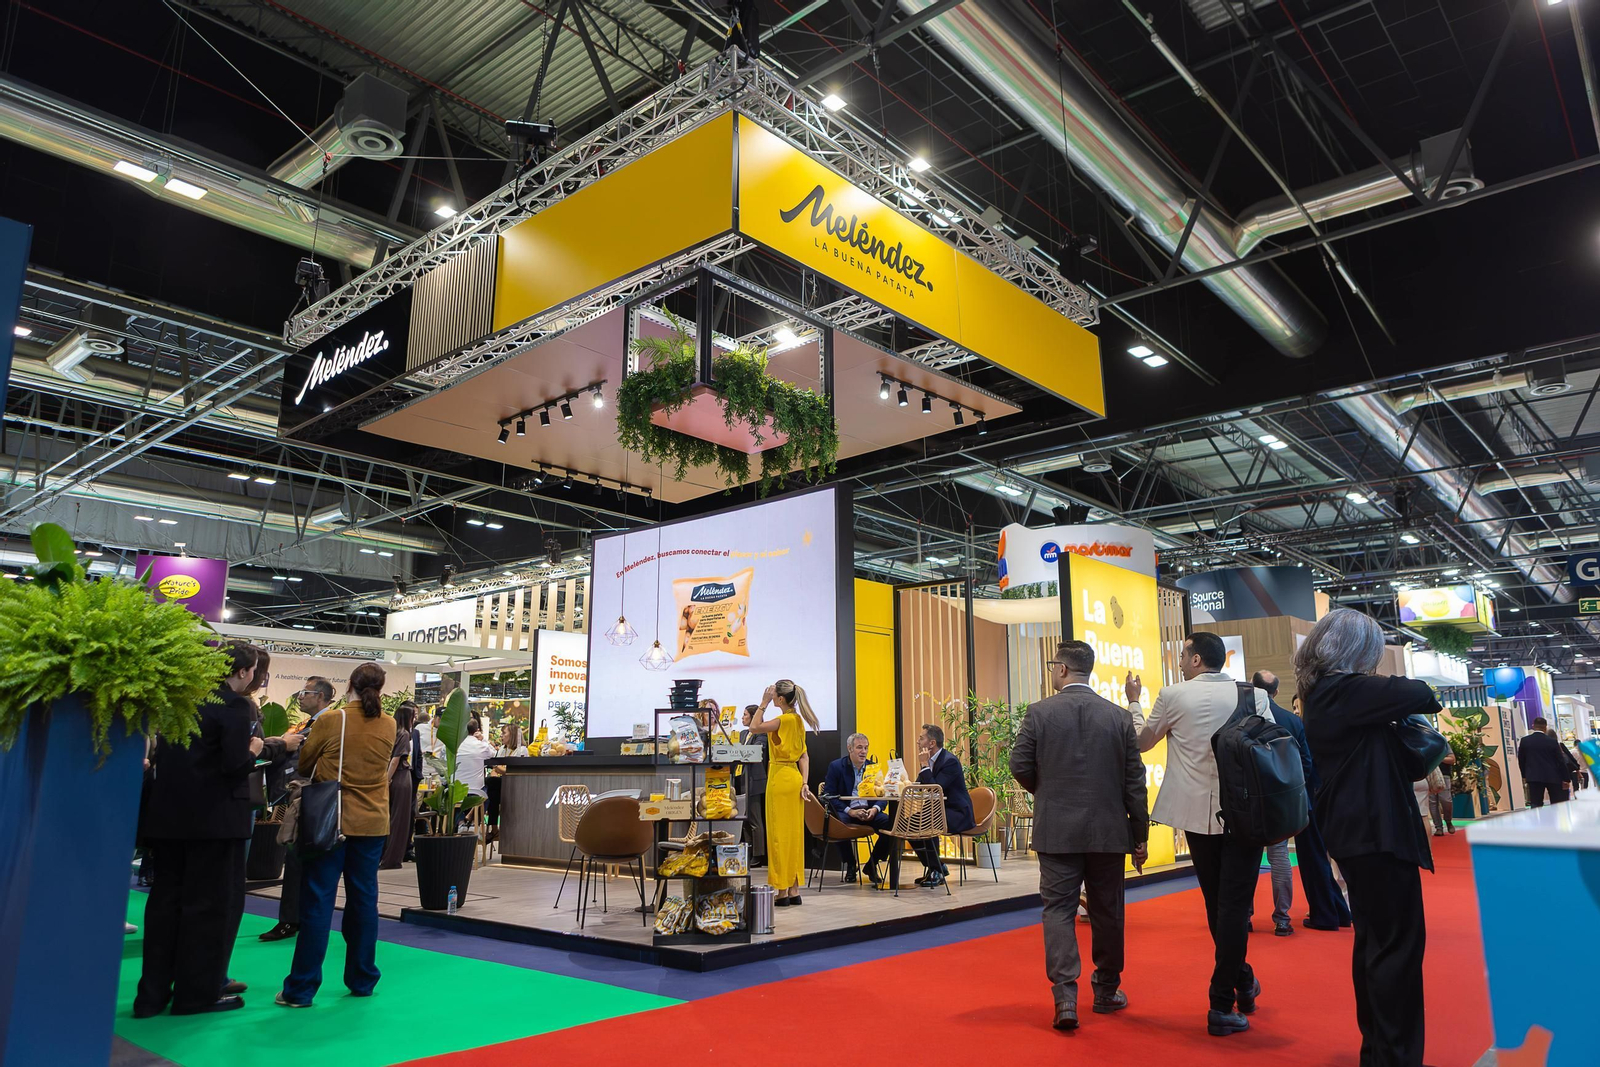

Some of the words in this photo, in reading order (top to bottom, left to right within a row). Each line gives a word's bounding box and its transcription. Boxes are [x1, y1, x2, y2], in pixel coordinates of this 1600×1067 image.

[814, 237, 829, 252] LA
[833, 248, 872, 276] BUENA
[876, 271, 915, 299] PATATA
[657, 548, 690, 559] buscamos
[691, 548, 721, 557] conectar
[723, 549, 730, 557] el
[169, 587, 189, 595] Pride
[1192, 590, 1225, 604] Source
[694, 603, 733, 615] ENERGY
[1082, 589, 1107, 625] La
[1085, 630, 1145, 670] Buena
[551, 655, 587, 668] Somos
[549, 683, 556, 695] y
[1089, 672, 1151, 709] Pataa
